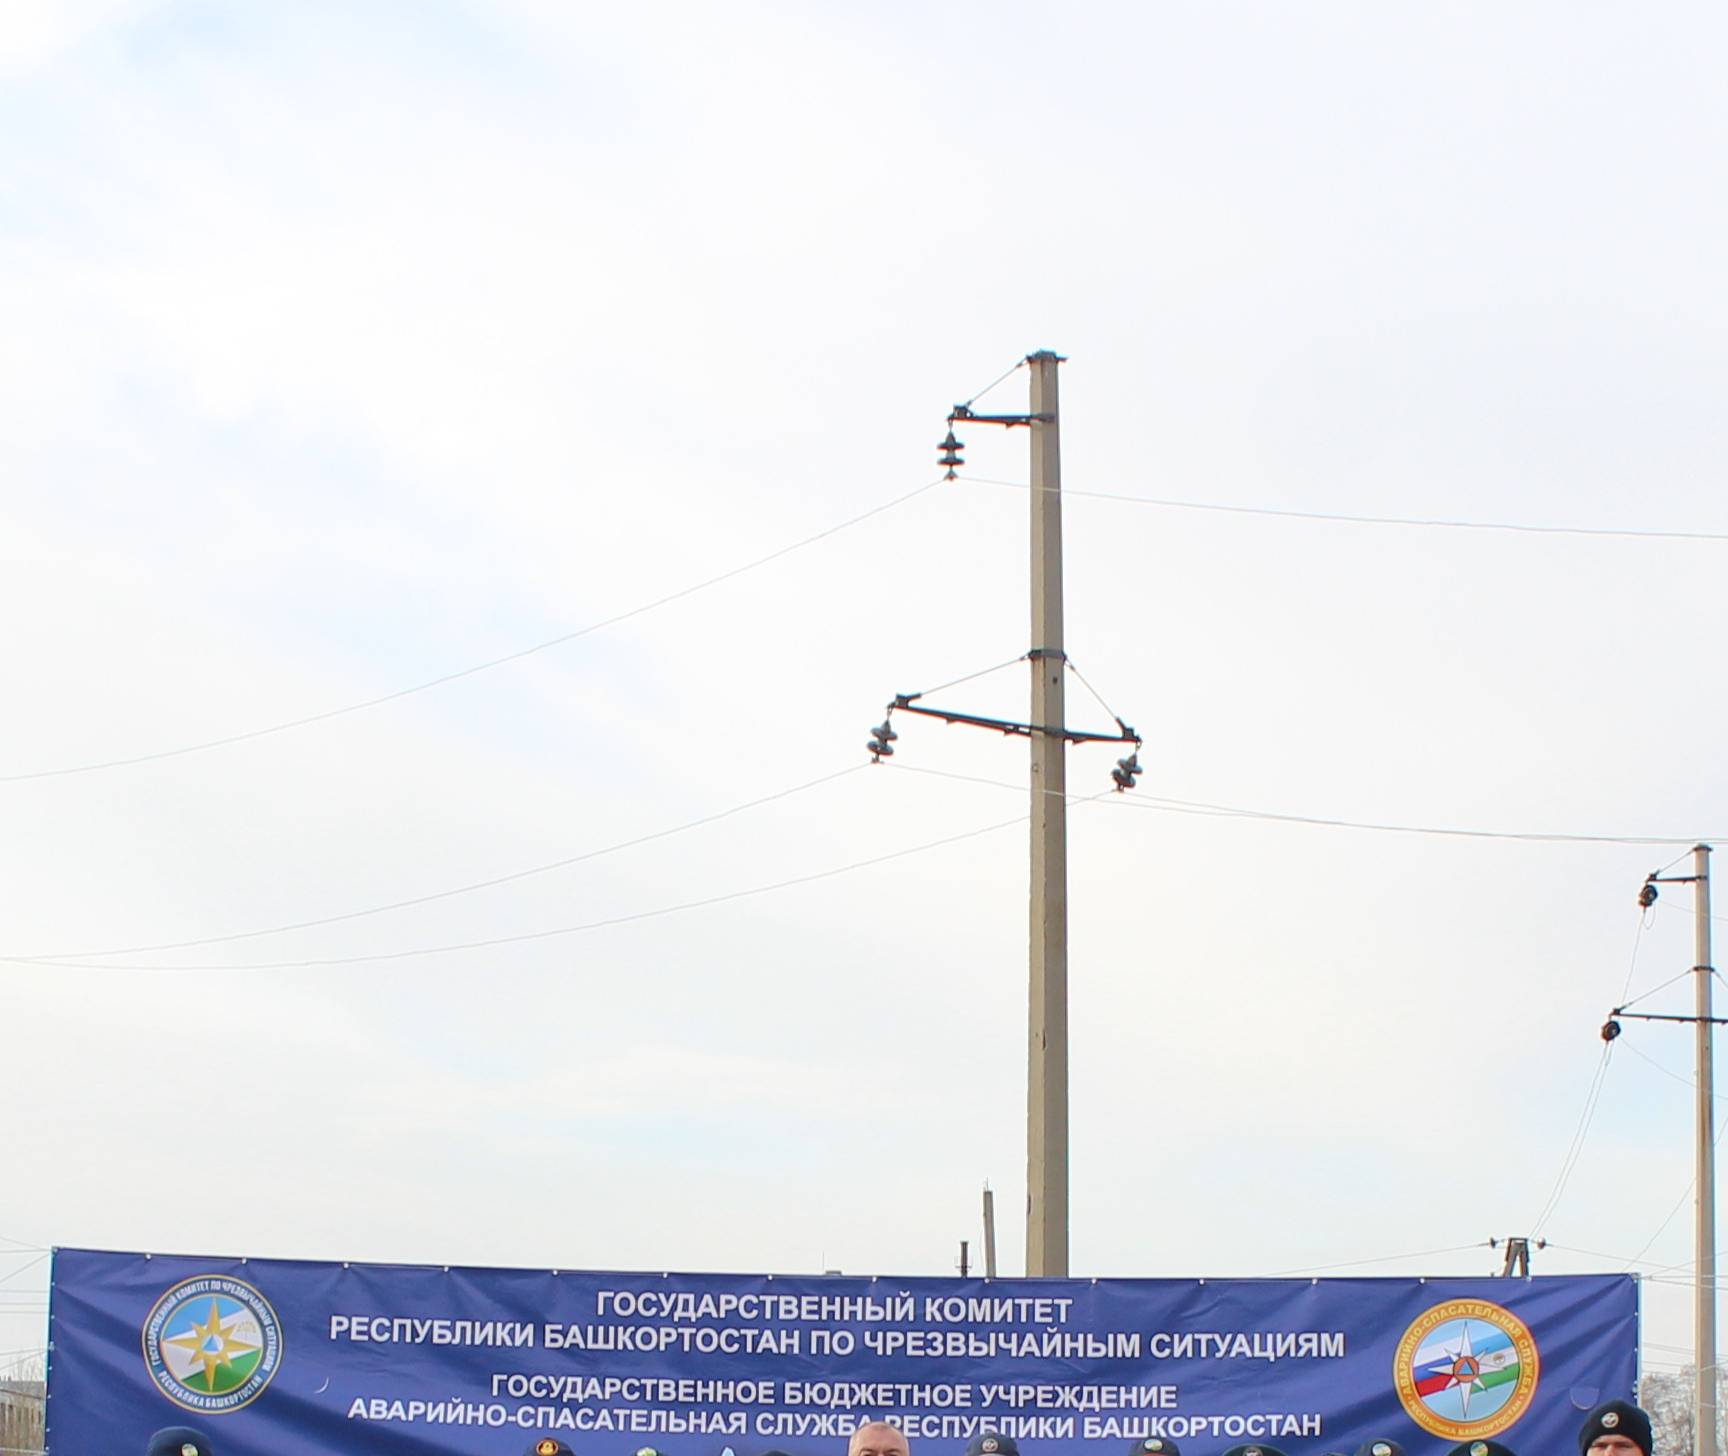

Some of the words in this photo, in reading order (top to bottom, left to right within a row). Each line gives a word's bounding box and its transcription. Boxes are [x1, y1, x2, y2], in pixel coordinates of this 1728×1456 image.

[597, 1290, 915, 1322] ГОСУДАРСТВЕННЫЙ
[925, 1298, 1073, 1323] КОМИТЕТ
[330, 1315, 534, 1347] РЕСПУБЛИКИ
[544, 1324, 800, 1354] БАШКОРТОСТАН
[810, 1330, 855, 1355] ПО
[864, 1326, 1140, 1358] ЧРЕЗВЫЧАЙНЫМ
[1150, 1333, 1344, 1361] СИТУАЦИЯМ
[491, 1374, 775, 1404] ГОСУДАРСТВЕННОЕ
[784, 1382, 972, 1409] БЮДЖЕТНОЕ
[979, 1385, 1177, 1412] УЧРЕЖДЕНИЕ
[347, 1397, 747, 1435] АВАРИЙНО-СПАСАТЕЛЬНАЯ
[1084, 1414, 1321, 1438] БАШКОРТОСТАН
